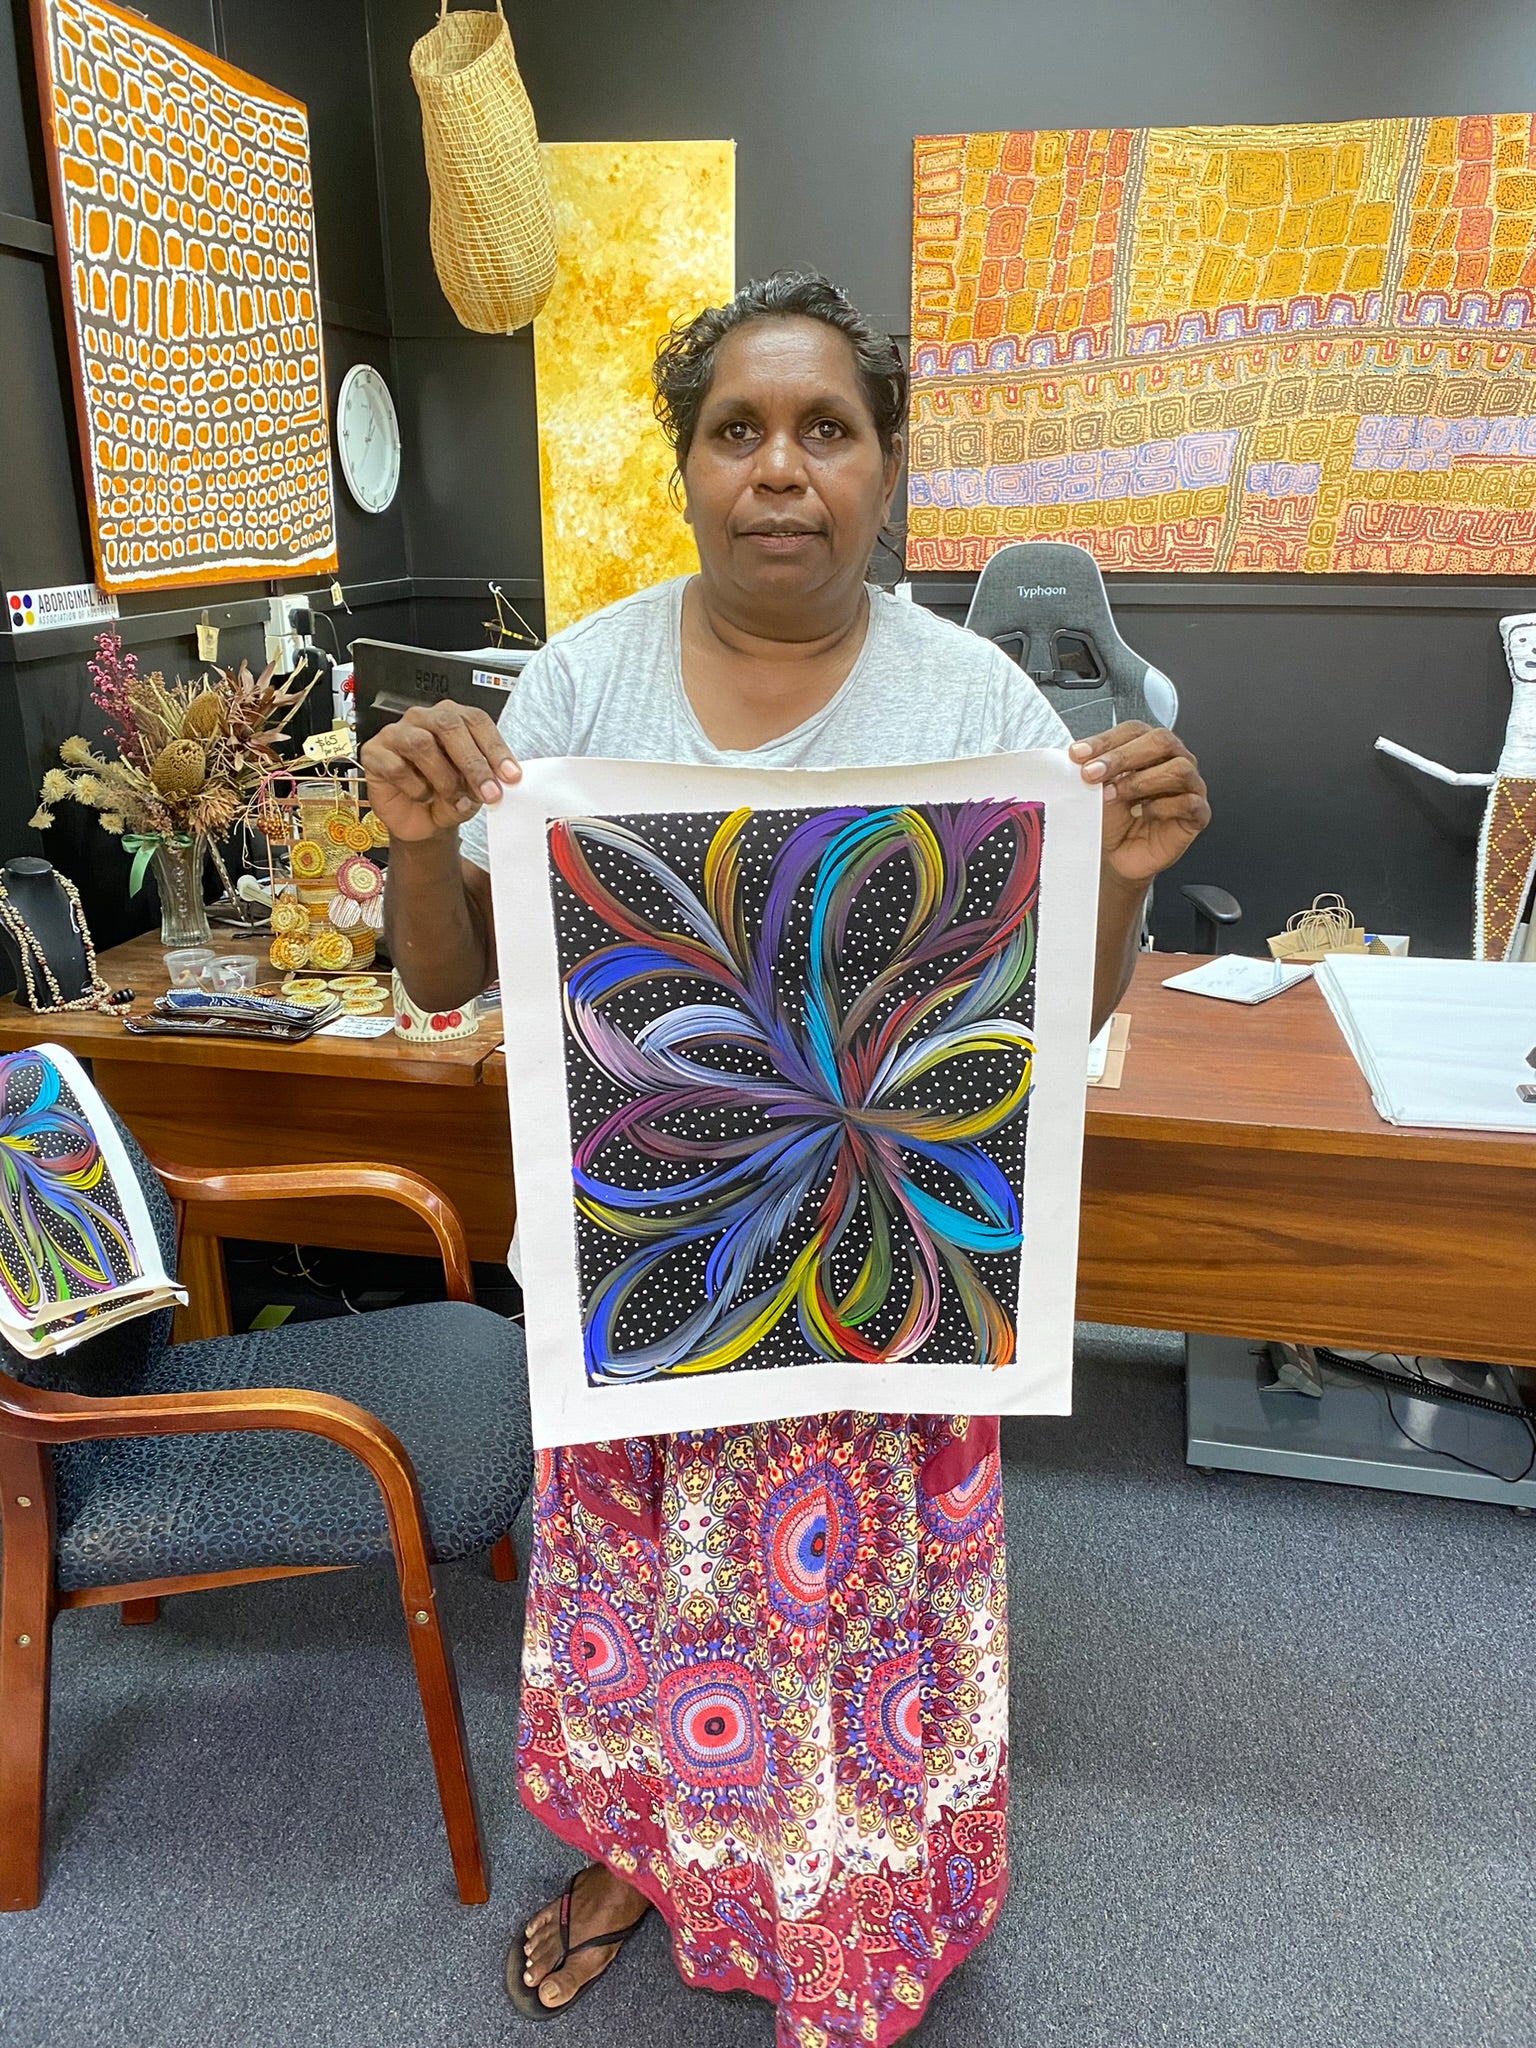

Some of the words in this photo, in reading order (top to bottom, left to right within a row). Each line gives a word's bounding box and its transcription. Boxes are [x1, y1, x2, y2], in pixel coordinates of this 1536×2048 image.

[1016, 585, 1066, 598] Typhoon
[38, 588, 95, 614] ABORIGINAL
[315, 734, 338, 752] $65
